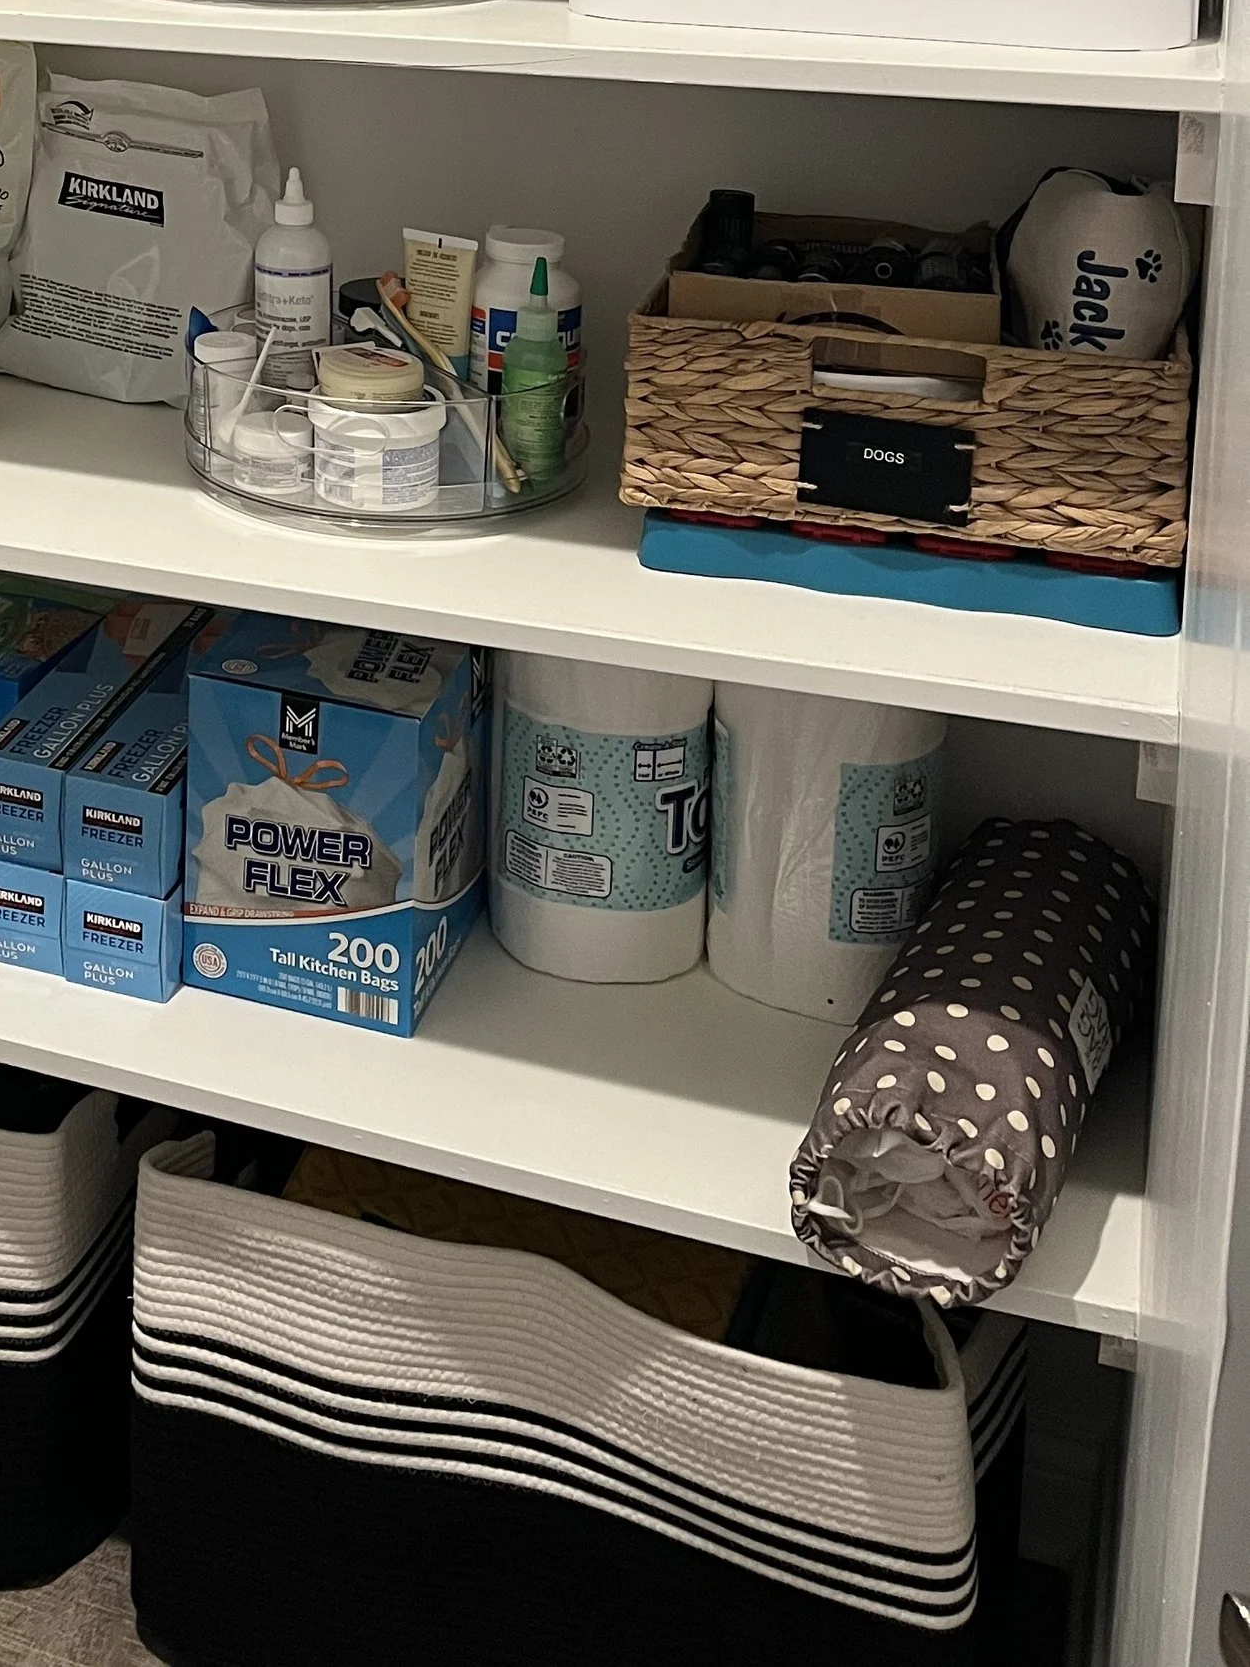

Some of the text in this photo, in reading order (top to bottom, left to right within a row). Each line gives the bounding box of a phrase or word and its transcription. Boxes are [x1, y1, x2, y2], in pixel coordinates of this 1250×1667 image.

[68, 177, 160, 210] KIRKLAND
[64, 194, 161, 219] Signature
[1069, 250, 1129, 352] Jack
[863, 447, 905, 465] DOGS
[9, 706, 68, 756] FREEZER
[32, 683, 115, 760] GALLON PLUS
[281, 732, 317, 747] Member's
[289, 741, 308, 752] Mark
[107, 728, 165, 780] FREEZER
[131, 730, 183, 783] GALLON
[85, 808, 141, 827] KIRKLAND
[81, 826, 144, 849] FREEZER
[225, 814, 373, 869] POWER
[81, 857, 133, 876] GALLON
[82, 868, 114, 883] PLUS
[243, 857, 349, 907] FLEX
[189, 902, 220, 916] EXPAND
[244, 908, 295, 918] DRAWSTRING
[86, 912, 142, 933] KIRKLAND
[82, 931, 144, 955] FREEZER
[327, 932, 400, 974] 200
[201, 956, 219, 969] USA
[414, 915, 448, 996] 200
[83, 961, 135, 980] GALLON
[84, 972, 116, 986] PLUS
[268, 947, 296, 967] Tall
[298, 955, 357, 981] Kitchen
[360, 968, 399, 992] Bags
